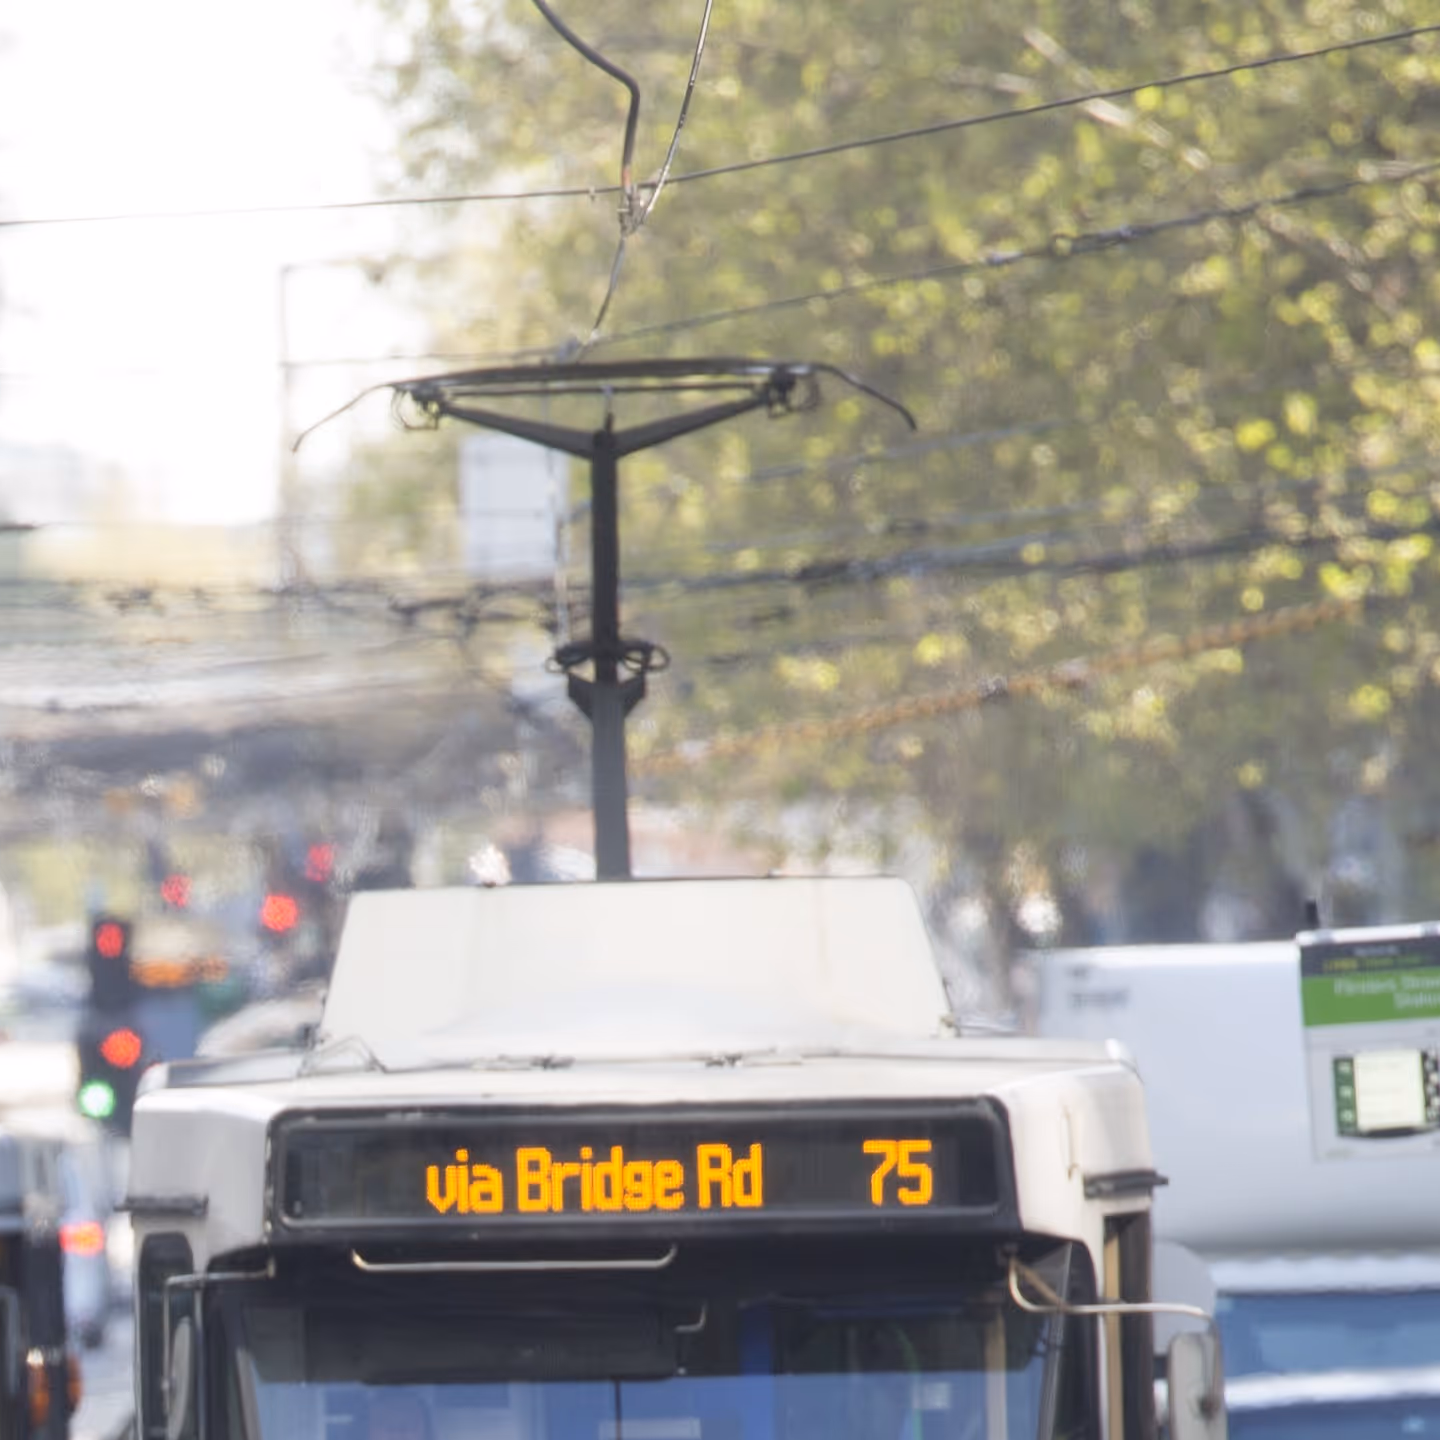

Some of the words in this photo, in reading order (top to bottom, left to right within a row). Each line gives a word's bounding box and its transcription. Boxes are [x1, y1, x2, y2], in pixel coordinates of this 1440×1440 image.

[427, 1146, 503, 1214] via
[516, 1144, 684, 1214] Bridge
[697, 1143, 763, 1209] Rd
[863, 1139, 933, 1206] 75
